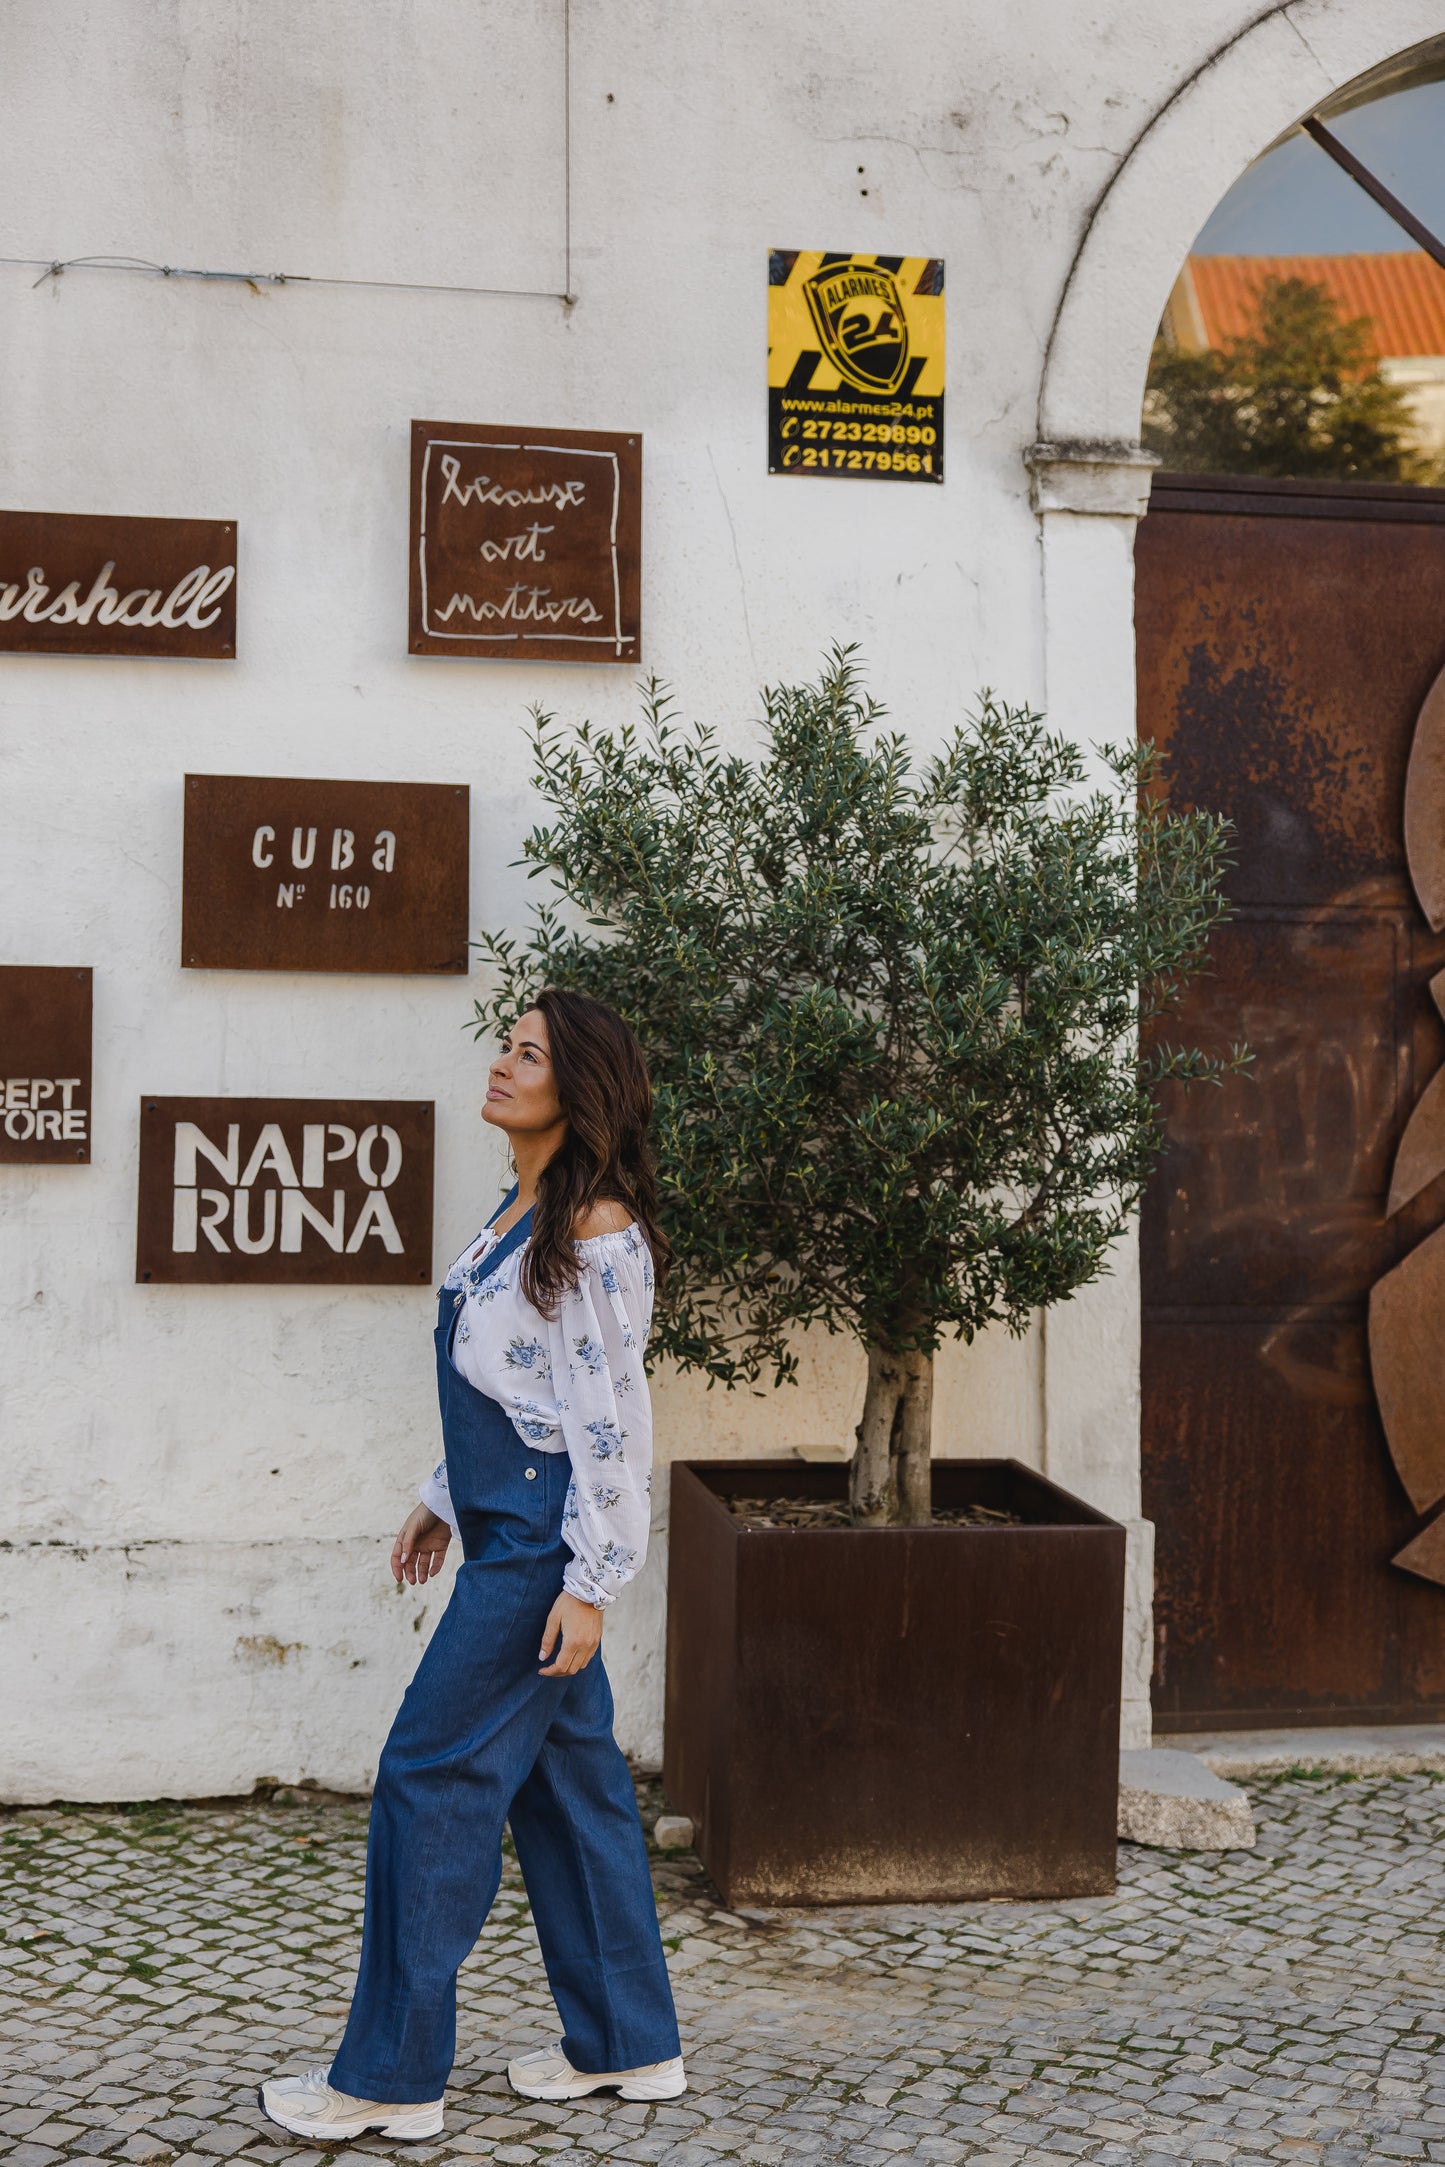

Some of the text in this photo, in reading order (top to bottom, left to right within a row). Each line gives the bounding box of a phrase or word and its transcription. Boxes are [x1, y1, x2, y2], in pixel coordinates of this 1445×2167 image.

[826, 276, 891, 308] ALARMES
[842, 312, 899, 348] 24
[781, 399, 934, 421] www.alarmes24.pt
[802, 420, 936, 446] 272329890
[802, 448, 933, 473] 217279561
[480, 522, 555, 562] art
[329, 883, 371, 910] 160
[0, 1078, 82, 1110] EPT
[173, 1121, 403, 1189] NAPO
[172, 1187, 405, 1255] RUNA
